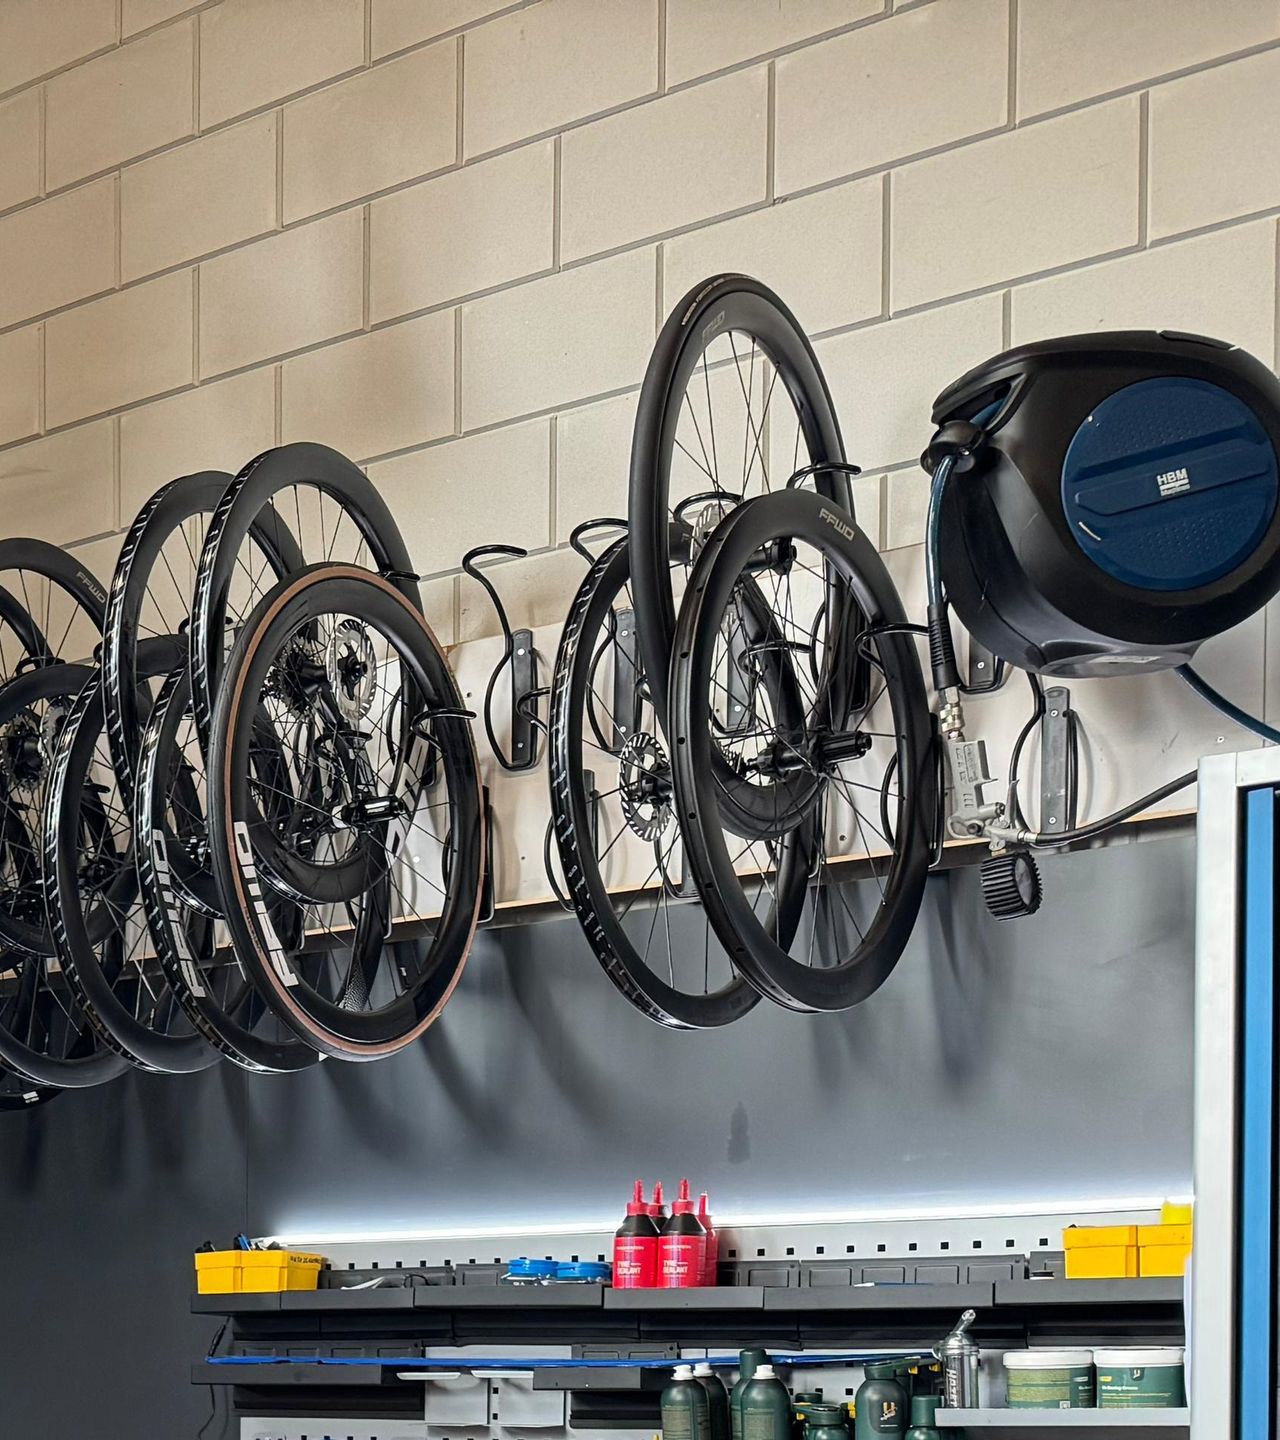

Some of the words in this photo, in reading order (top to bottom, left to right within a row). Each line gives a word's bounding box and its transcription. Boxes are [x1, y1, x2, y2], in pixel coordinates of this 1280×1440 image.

[1156, 467, 1188, 486] HBM
[819, 507, 855, 541] FFWD
[76, 571, 106, 604] FFWD
